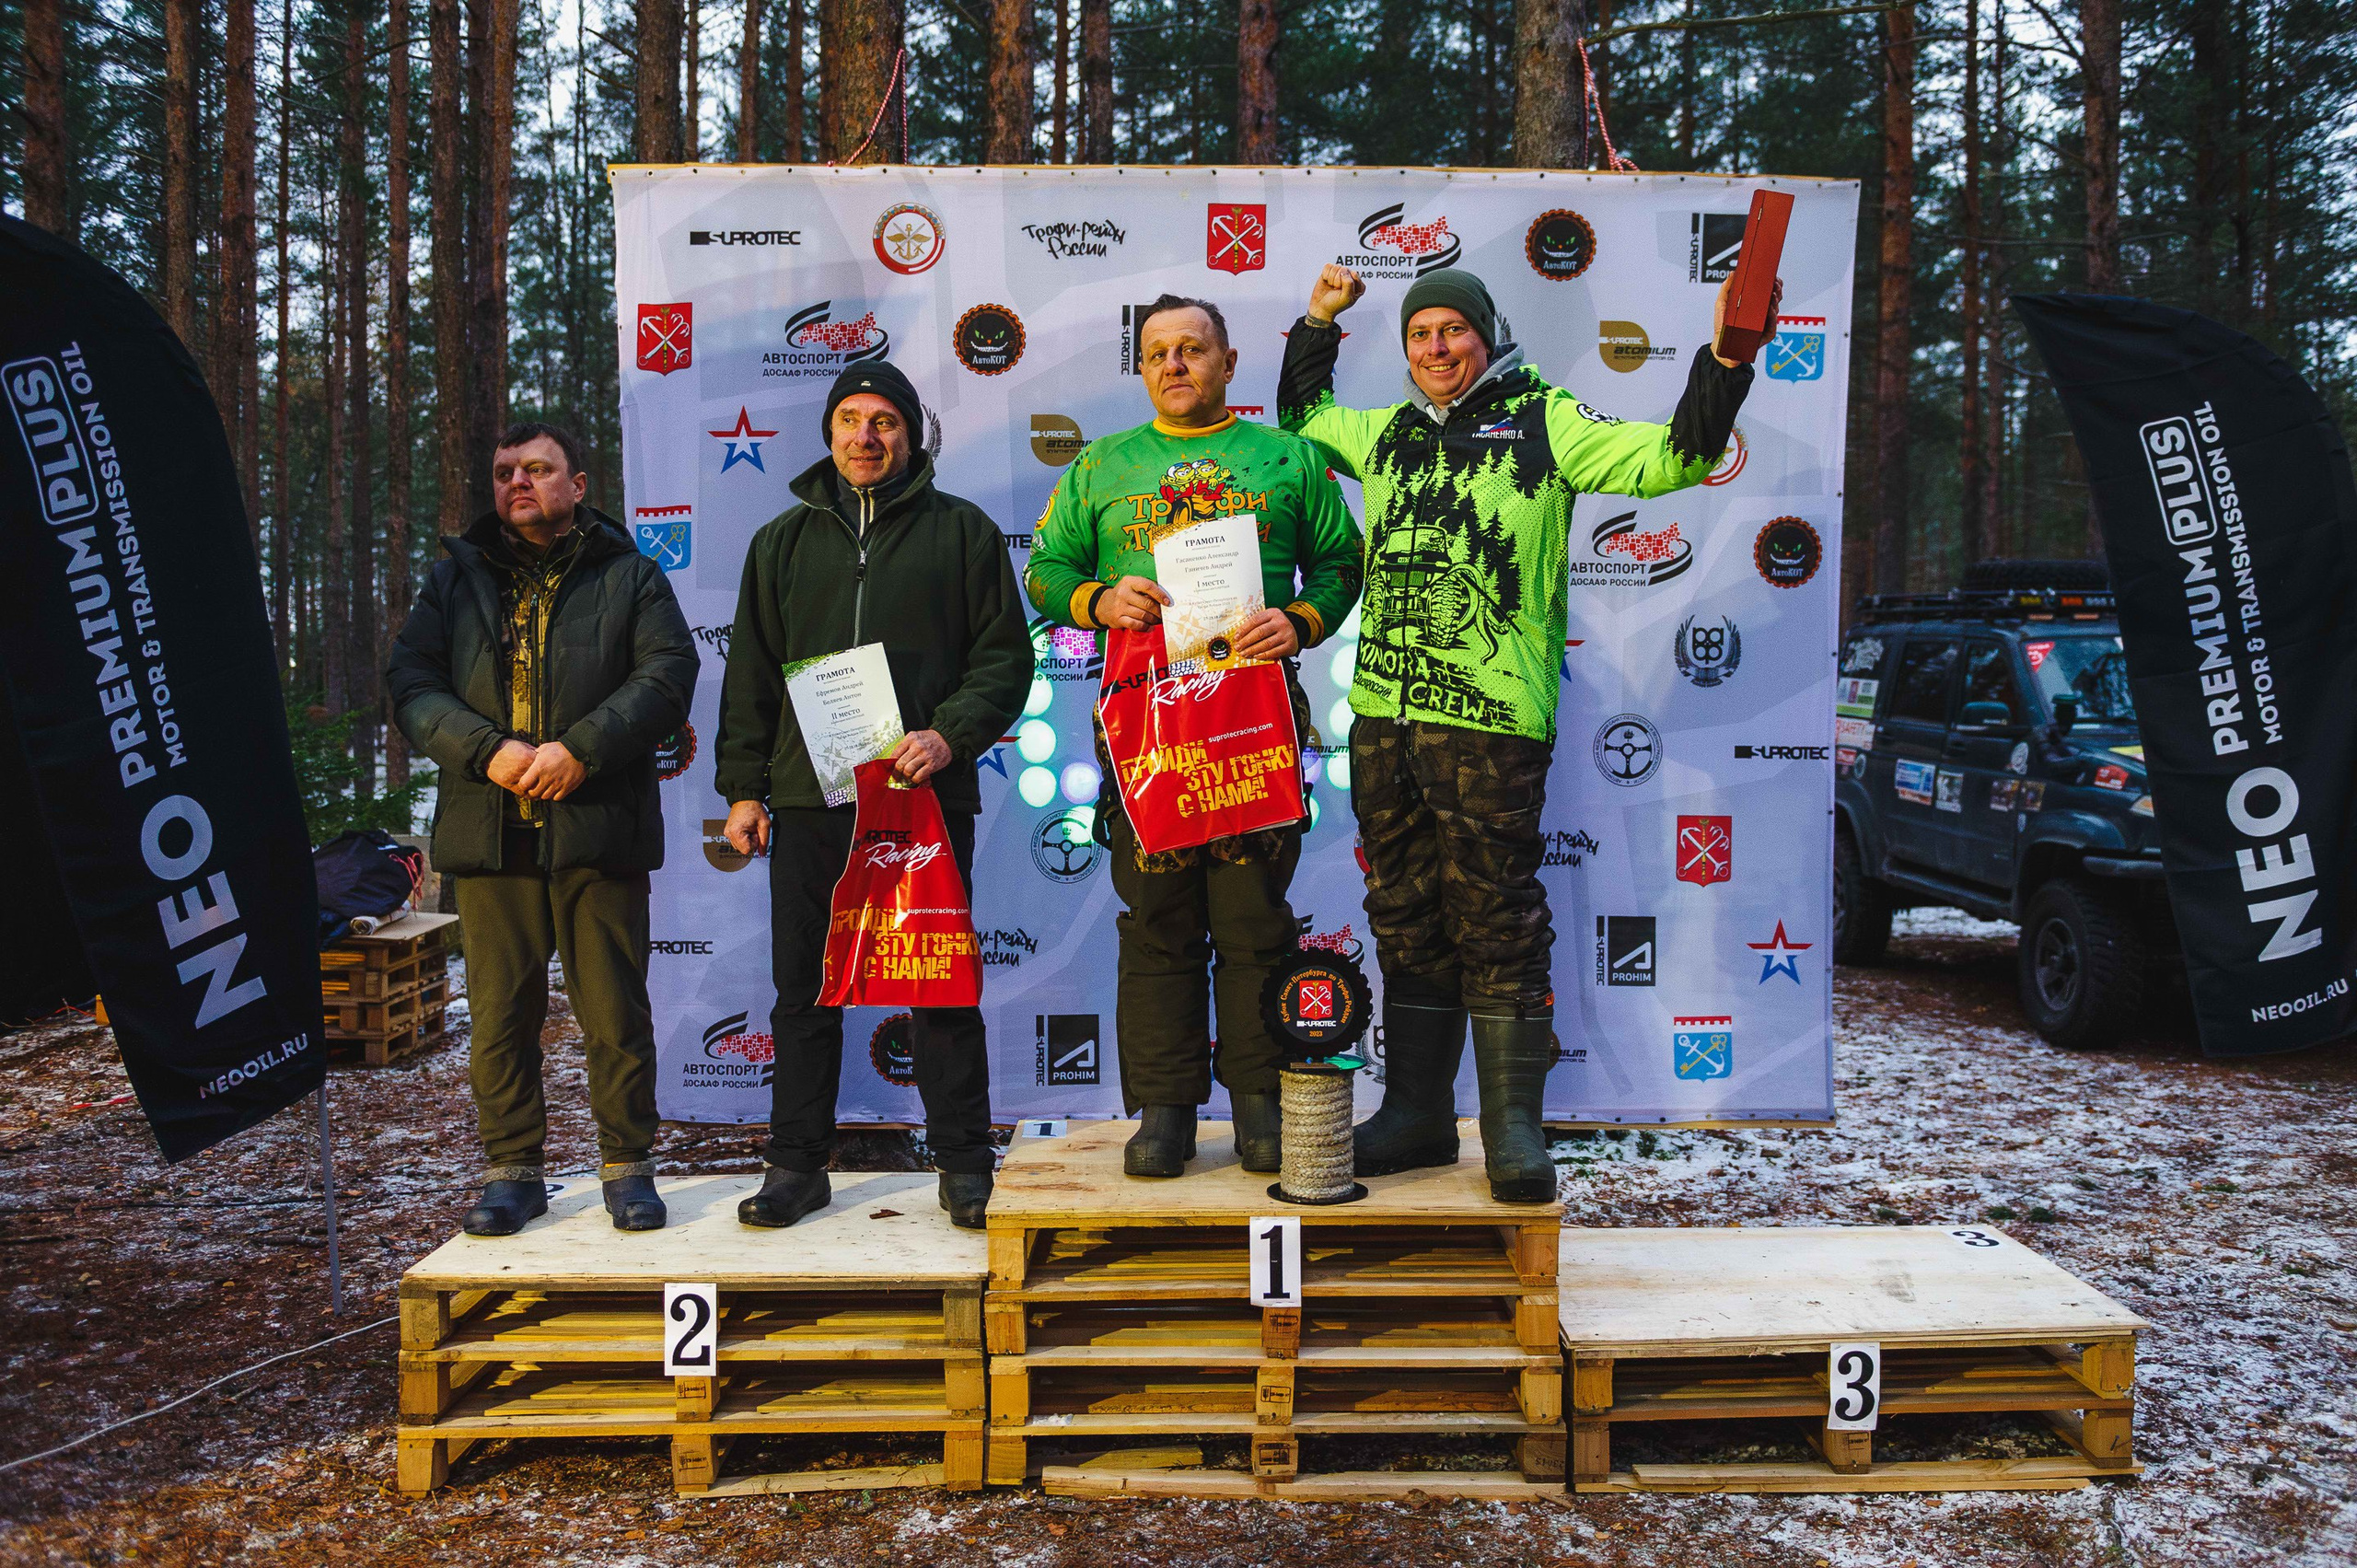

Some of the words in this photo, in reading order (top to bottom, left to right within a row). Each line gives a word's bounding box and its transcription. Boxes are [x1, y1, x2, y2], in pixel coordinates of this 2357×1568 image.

[708, 230, 801, 246] SUPROTEC
[1021, 219, 1126, 245] Трофи-рейды
[1048, 236, 1108, 260] России
[1335, 255, 1414, 267] АВТОСПОРТ
[1689, 232, 1700, 283] SUPROTEC
[1376, 271, 1414, 280] РОССИИ
[1705, 269, 1733, 279] PRO
[1609, 337, 1643, 345] SUPROTEC
[762, 352, 842, 365] АВТОСПОРТ
[1120, 325, 1131, 376] SUPROTEC
[1614, 345, 1677, 355] atomium
[61, 341, 92, 395] OIL
[972, 355, 1006, 366] АвтоКОТ
[762, 368, 802, 378] ДОСААФ
[804, 368, 842, 377] РОССИИ
[2194, 401, 2221, 443] OIL
[13, 368, 89, 515] PLUS
[1039, 430, 1076, 438] SUPROTEC
[1046, 439, 1093, 448] atomi
[2150, 425, 2209, 537] PLUS
[81, 401, 156, 635] TRANSMISSION
[1185, 535, 1225, 548] ГРАМОТА
[2207, 447, 2262, 634] TRANSMISSION
[1207, 552, 1239, 560] Александр
[1211, 561, 1233, 570] Андрей
[1570, 563, 1646, 575] АВТОСПОРТ
[1570, 578, 1608, 587] ДОСААФ
[1610, 578, 1646, 587] РОССИИ
[142, 640, 161, 657] &
[2178, 546, 2249, 756] PREMIUM
[2247, 637, 2266, 653] &
[58, 526, 157, 788] PREMIUM
[816, 667, 855, 681] ГРАМОТА
[1046, 673, 1084, 681] РОССИИ
[842, 680, 864, 691] Андрей
[1150, 670, 1237, 711] Racing
[843, 692, 862, 701] Антон
[1408, 681, 1485, 721] CREW
[2250, 656, 2283, 744] MOTOR
[147, 662, 188, 768] MOTOR
[839, 708, 861, 718] место
[1208, 723, 1273, 743] suprotecracing.com
[1750, 745, 1829, 760] SUPROTEC
[656, 760, 678, 770] оКОТ
[1120, 739, 1208, 784] ПРОЙДИ
[1183, 762, 1225, 792] ЭТУ
[1230, 743, 1295, 781] ГОНКУ
[1177, 795, 1195, 819] С
[1198, 776, 1270, 814] НАМИ!
[865, 842, 946, 872] Racing
[2226, 767, 2322, 962] NEO
[141, 795, 268, 1029] NEO
[649, 940, 713, 955] PROTEC
[875, 932, 915, 956] ЭТУ
[882, 957, 952, 980] НАМИ!
[1596, 936, 1605, 986] SUPROTEC
[1328, 972, 1337, 981] по
[1612, 973, 1652, 982] PROHIM
[2251, 978, 2349, 1022] NEOOIL.RU
[199, 1033, 308, 1099] NEOOIL.RU
[683, 1063, 759, 1075] АВТОСПОРТ
[888, 1065, 912, 1074] АвтоК
[1037, 1036, 1045, 1086] SUPROTEC
[683, 1078, 720, 1089] ДОСААФ
[722, 1078, 759, 1088] РОССИИ
[1052, 1071, 1095, 1081] PROHIM
[1035, 1122, 1056, 1136] 1
[1952, 1230, 2000, 1248] 3
[1259, 1225, 1291, 1299] 1
[670, 1293, 711, 1365] 2
[1835, 1350, 1875, 1422] 3
